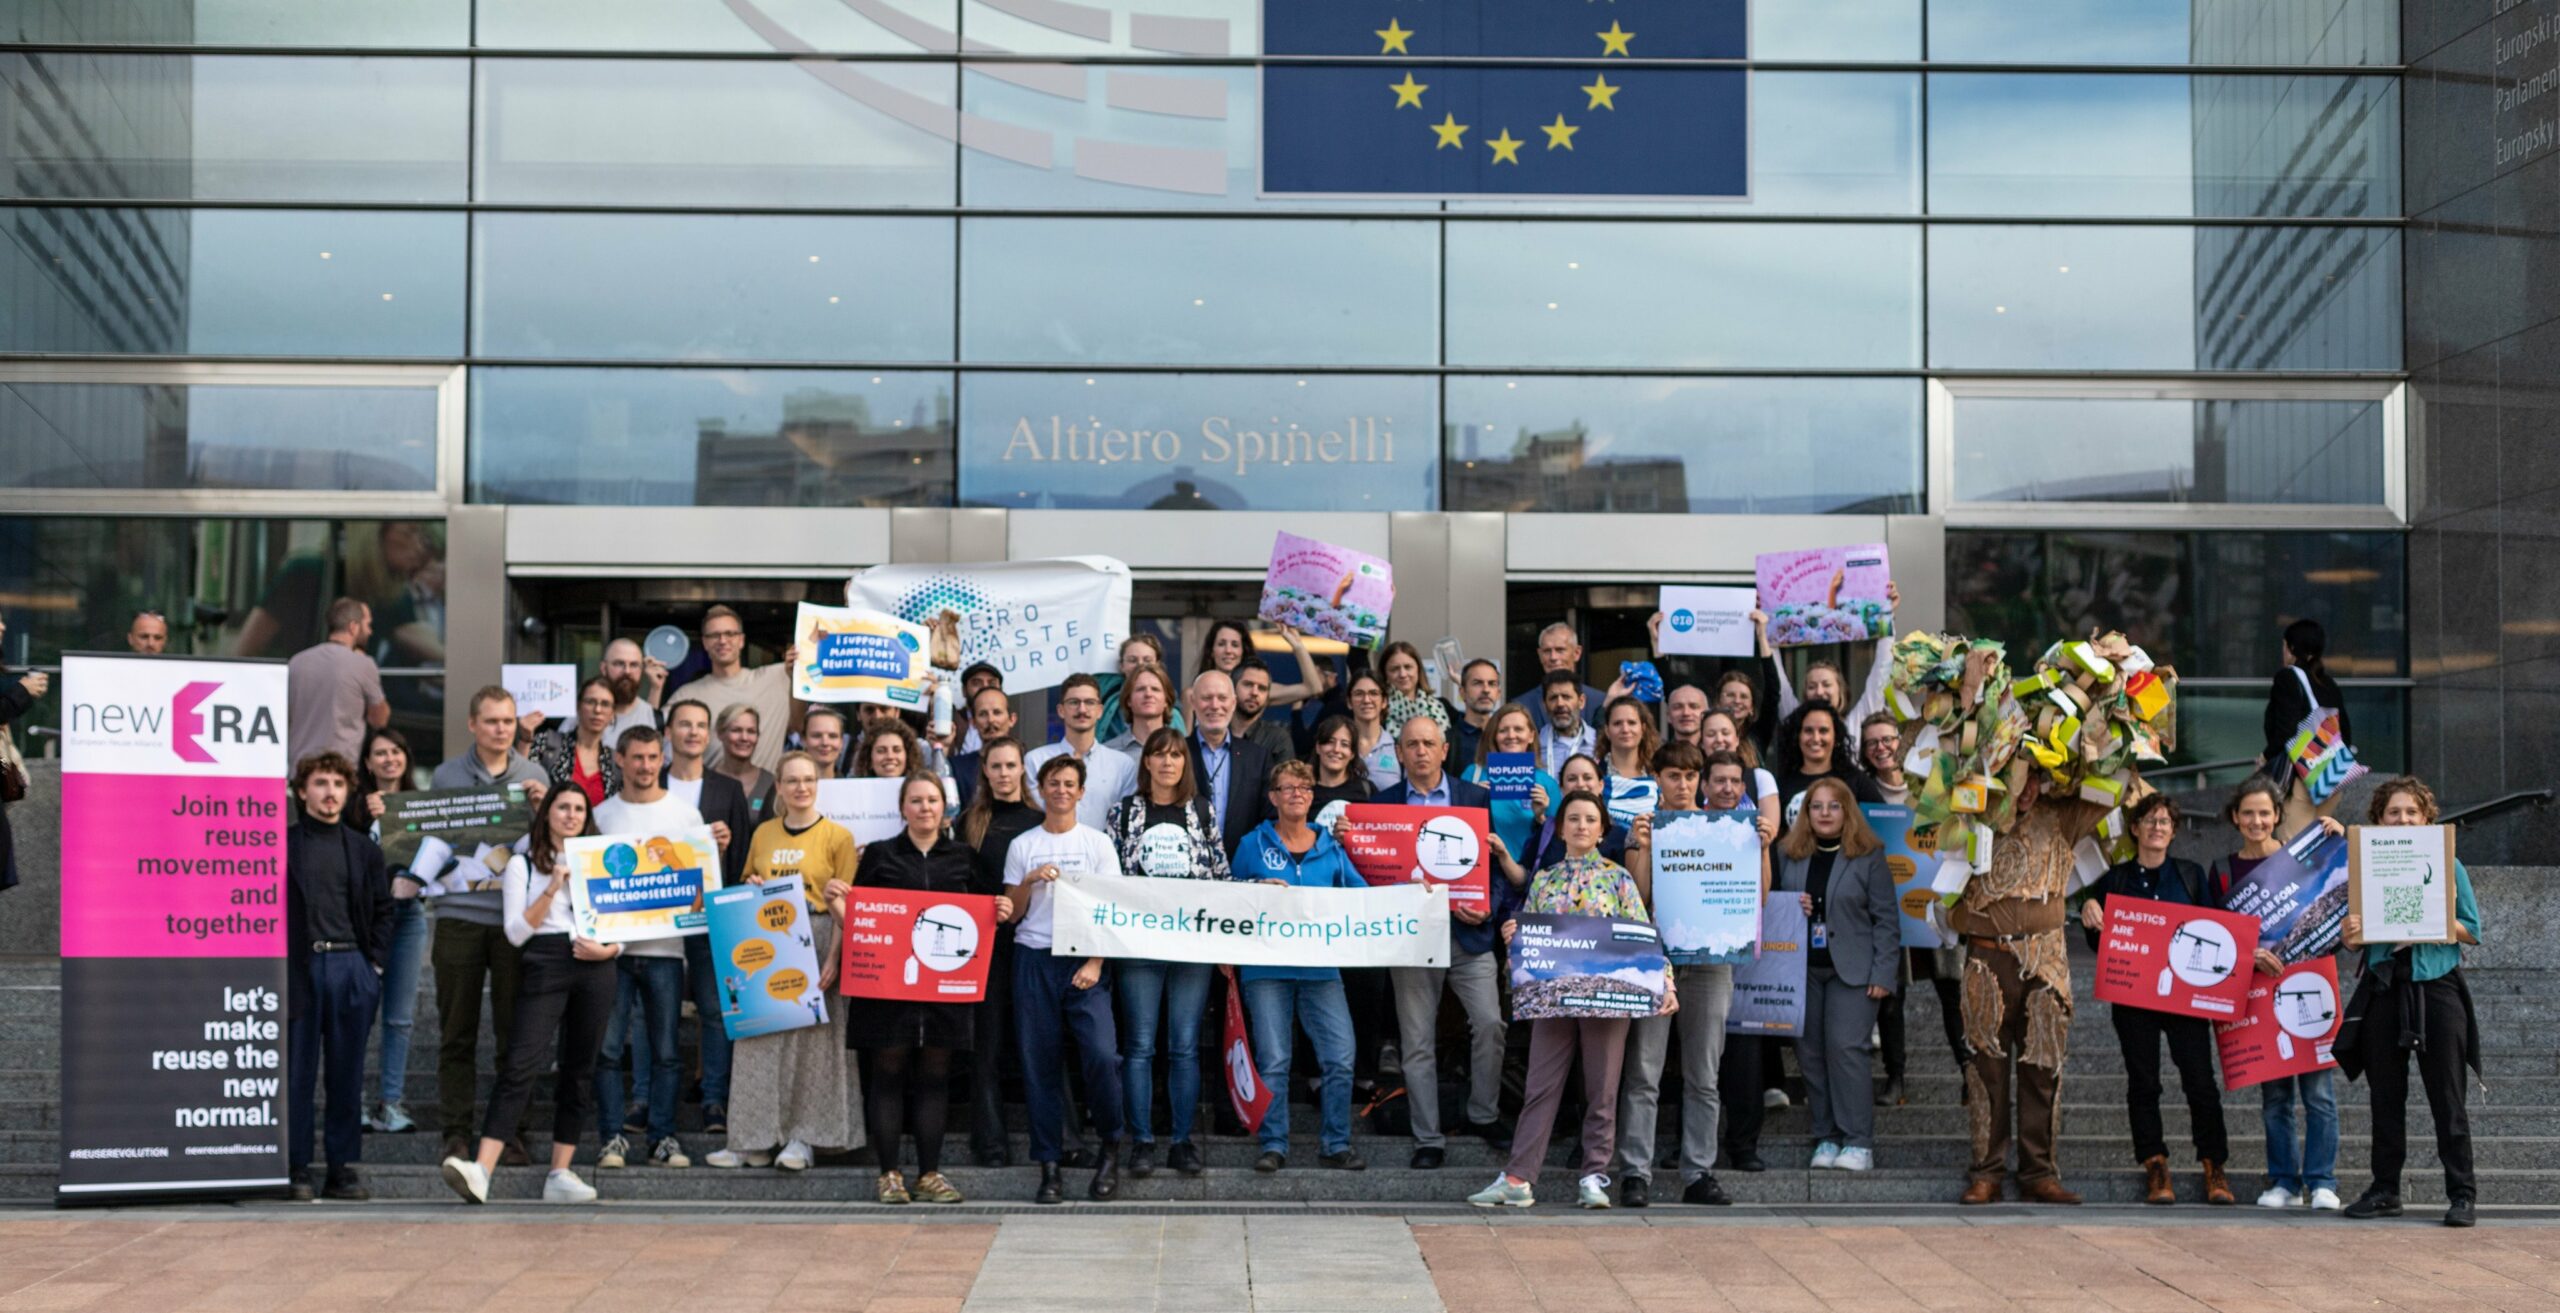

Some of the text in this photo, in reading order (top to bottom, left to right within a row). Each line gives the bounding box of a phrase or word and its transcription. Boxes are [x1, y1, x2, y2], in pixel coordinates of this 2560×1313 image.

[2496, 13, 2551, 65] Europski
[1002, 416, 1396, 475] Altiero Spinelli
[969, 604, 1039, 630] ERO
[843, 636, 889, 647] SUPPORT
[830, 647, 895, 660] MANDATORY
[1002, 632, 1116, 673] UROPE
[822, 659, 902, 674] REUSE TARGETS
[72, 703, 164, 734] new
[1488, 766, 1534, 774] NO PLASTIC
[172, 795, 278, 818] Join the
[1352, 822, 1414, 832] LE PLASTIQUE
[205, 828, 278, 847] reuse
[1352, 834, 1377, 843] C'EST
[1918, 840, 1936, 849] EU!
[2371, 838, 2395, 846] Scan
[1154, 842, 1173, 850] free
[1352, 847, 1397, 856] LE PLAN B
[1660, 848, 1706, 858] EINWEG
[771, 848, 805, 865] STOP
[137, 855, 278, 876] movement
[1154, 861, 1187, 871] plastic
[1661, 862, 1733, 872] WEGMACHEN
[609, 872, 680, 890] WE SUPPORT
[230, 883, 278, 905] and
[2226, 882, 2259, 910] VAMOS
[2260, 888, 2271, 899] O
[2273, 881, 2300, 906] FORA
[763, 904, 789, 917] HEY,
[854, 901, 908, 915] PLASTICS
[770, 917, 788, 928] EU!
[853, 917, 877, 928] ARE
[2113, 908, 2167, 927] PLASTICS
[2260, 899, 2300, 932] EMBORA
[166, 913, 279, 939] together
[1092, 902, 1419, 945] #breakfreefromplastic
[1521, 924, 1553, 936] MAKE
[2111, 923, 2134, 937] ARE
[852, 933, 893, 945] PLAN B
[1521, 936, 1598, 950] THROWAWAY
[1521, 947, 1540, 957] GO
[2109, 939, 2149, 955] PLAN B
[1521, 959, 1556, 970] AWAY
[2119, 958, 2131, 966] the
[851, 972, 880, 980] industry
[2105, 978, 2133, 990] industry
[224, 987, 279, 1012] let's
[1564, 998, 1650, 1011] SINGLE-USE PACKAGING.
[1596, 992, 1611, 1000] END
[1625, 994, 1639, 1002] ERA
[1640, 995, 1651, 1003] OF
[2250, 1015, 2259, 1025] B
[204, 1016, 279, 1041] make
[153, 1046, 279, 1070] reuse the
[224, 1076, 279, 1098] new
[175, 1103, 279, 1127] normal.
[69, 1143, 279, 1159] #REUSEREVOLUTION newreusealliance.eu
